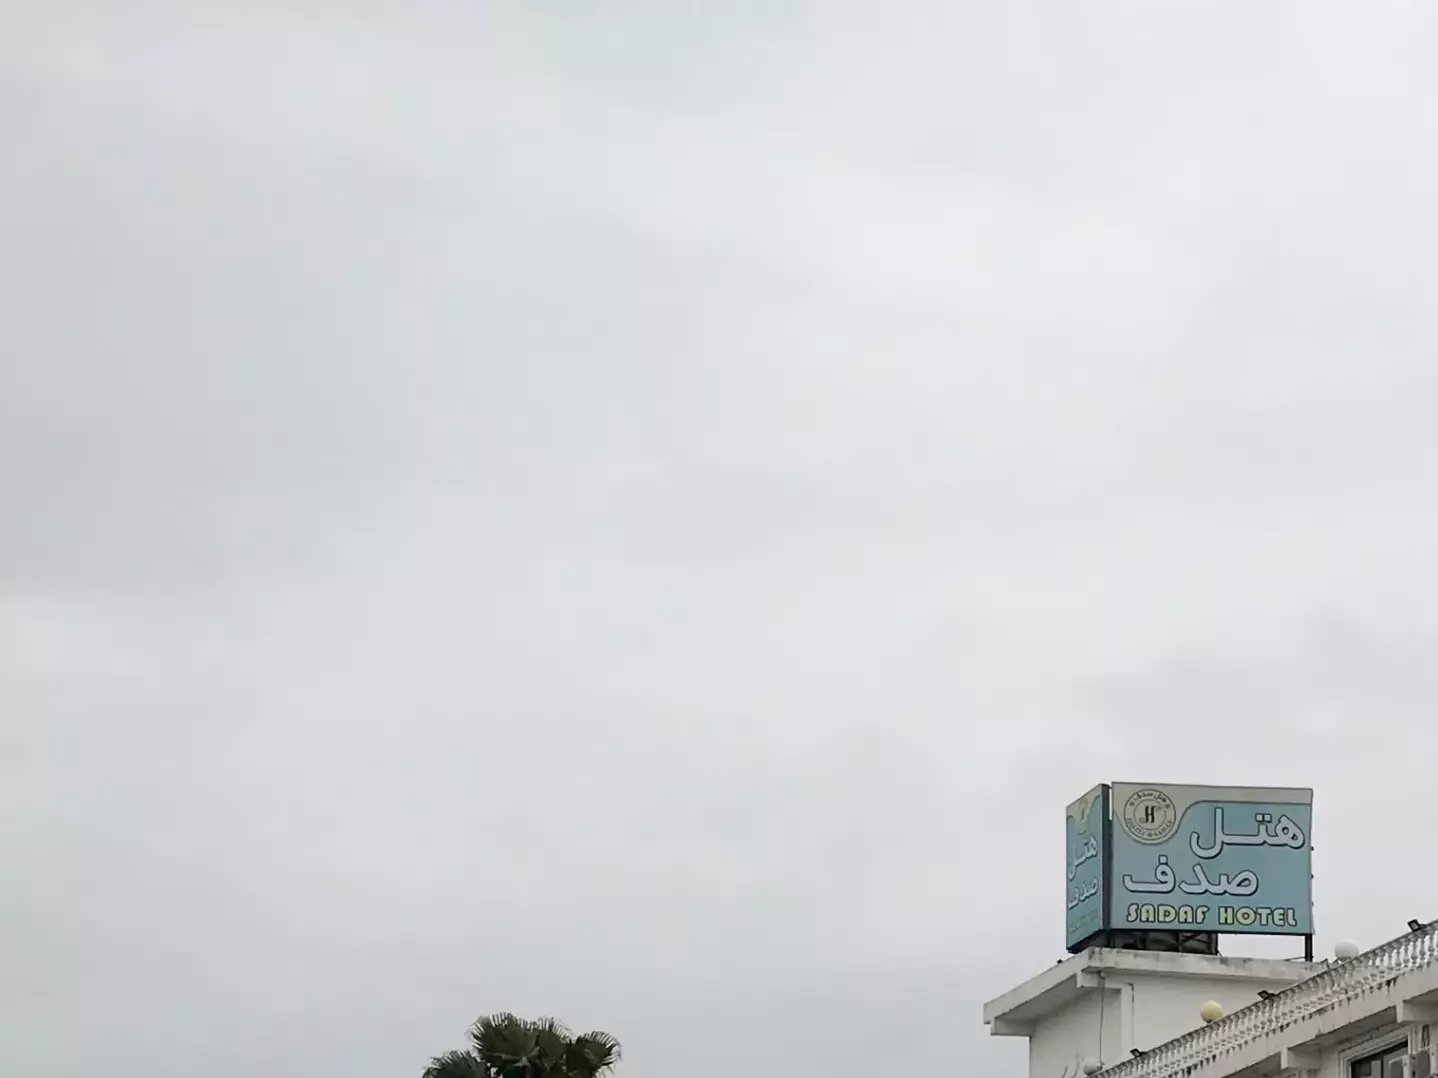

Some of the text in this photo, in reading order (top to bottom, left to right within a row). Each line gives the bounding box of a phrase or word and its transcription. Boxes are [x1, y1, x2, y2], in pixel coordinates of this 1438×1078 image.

[1190, 806, 1305, 859] هتل
[1068, 835, 1098, 881] هتل
[1123, 855, 1259, 896] صدف
[1068, 878, 1098, 910] صدف
[1126, 903, 1298, 926] SADAF HOTEL
